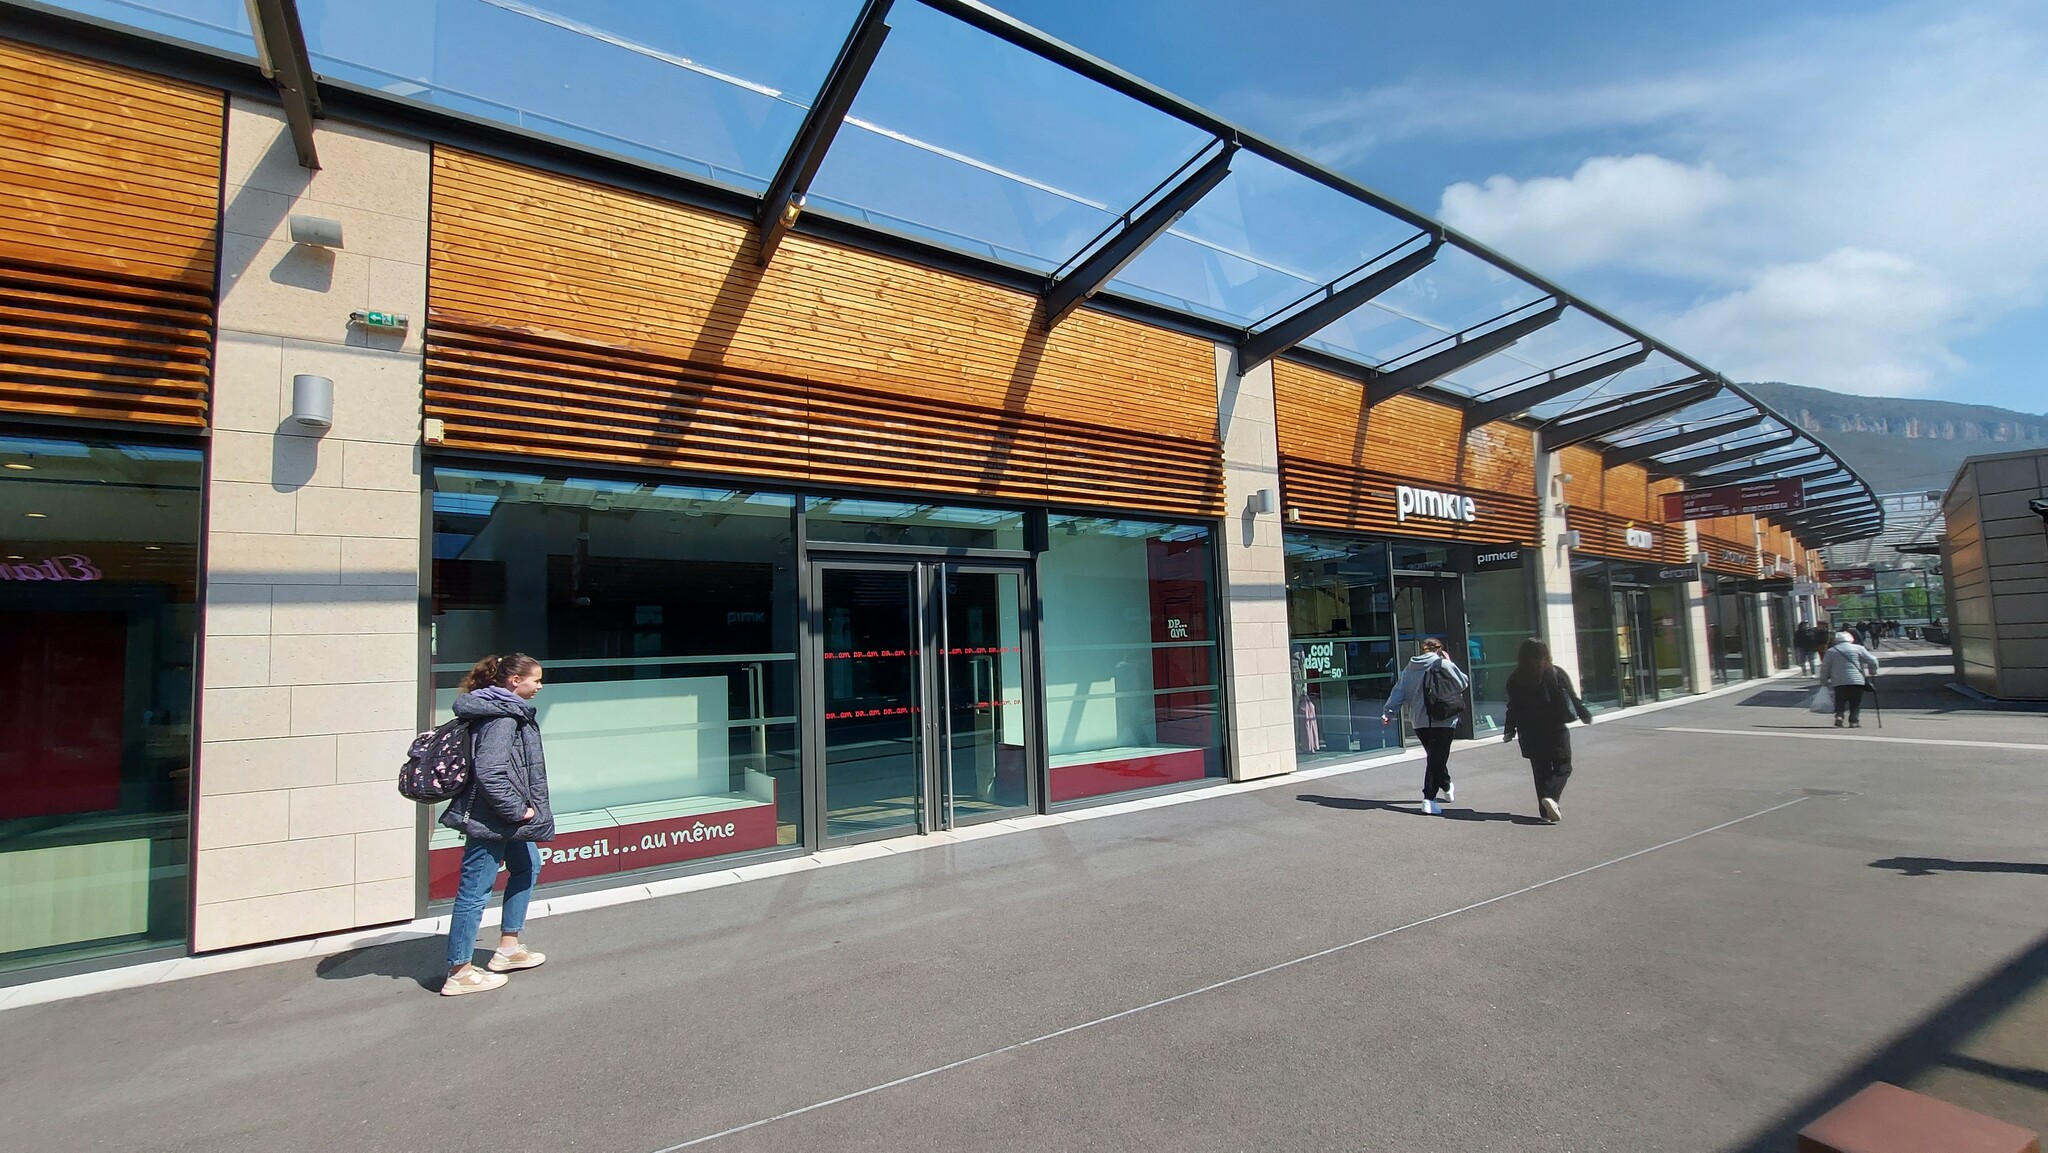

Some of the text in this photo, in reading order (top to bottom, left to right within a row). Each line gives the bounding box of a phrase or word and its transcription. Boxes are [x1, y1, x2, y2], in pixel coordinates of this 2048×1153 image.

[1396, 486, 1476, 522] pimkie
[1477, 550, 1518, 565] pimkie
[1170, 628, 1188, 638] am
[1311, 641, 1333, 656] cool
[1304, 654, 1330, 672] days
[641, 833, 667, 850] au
[670, 821, 736, 846] même
